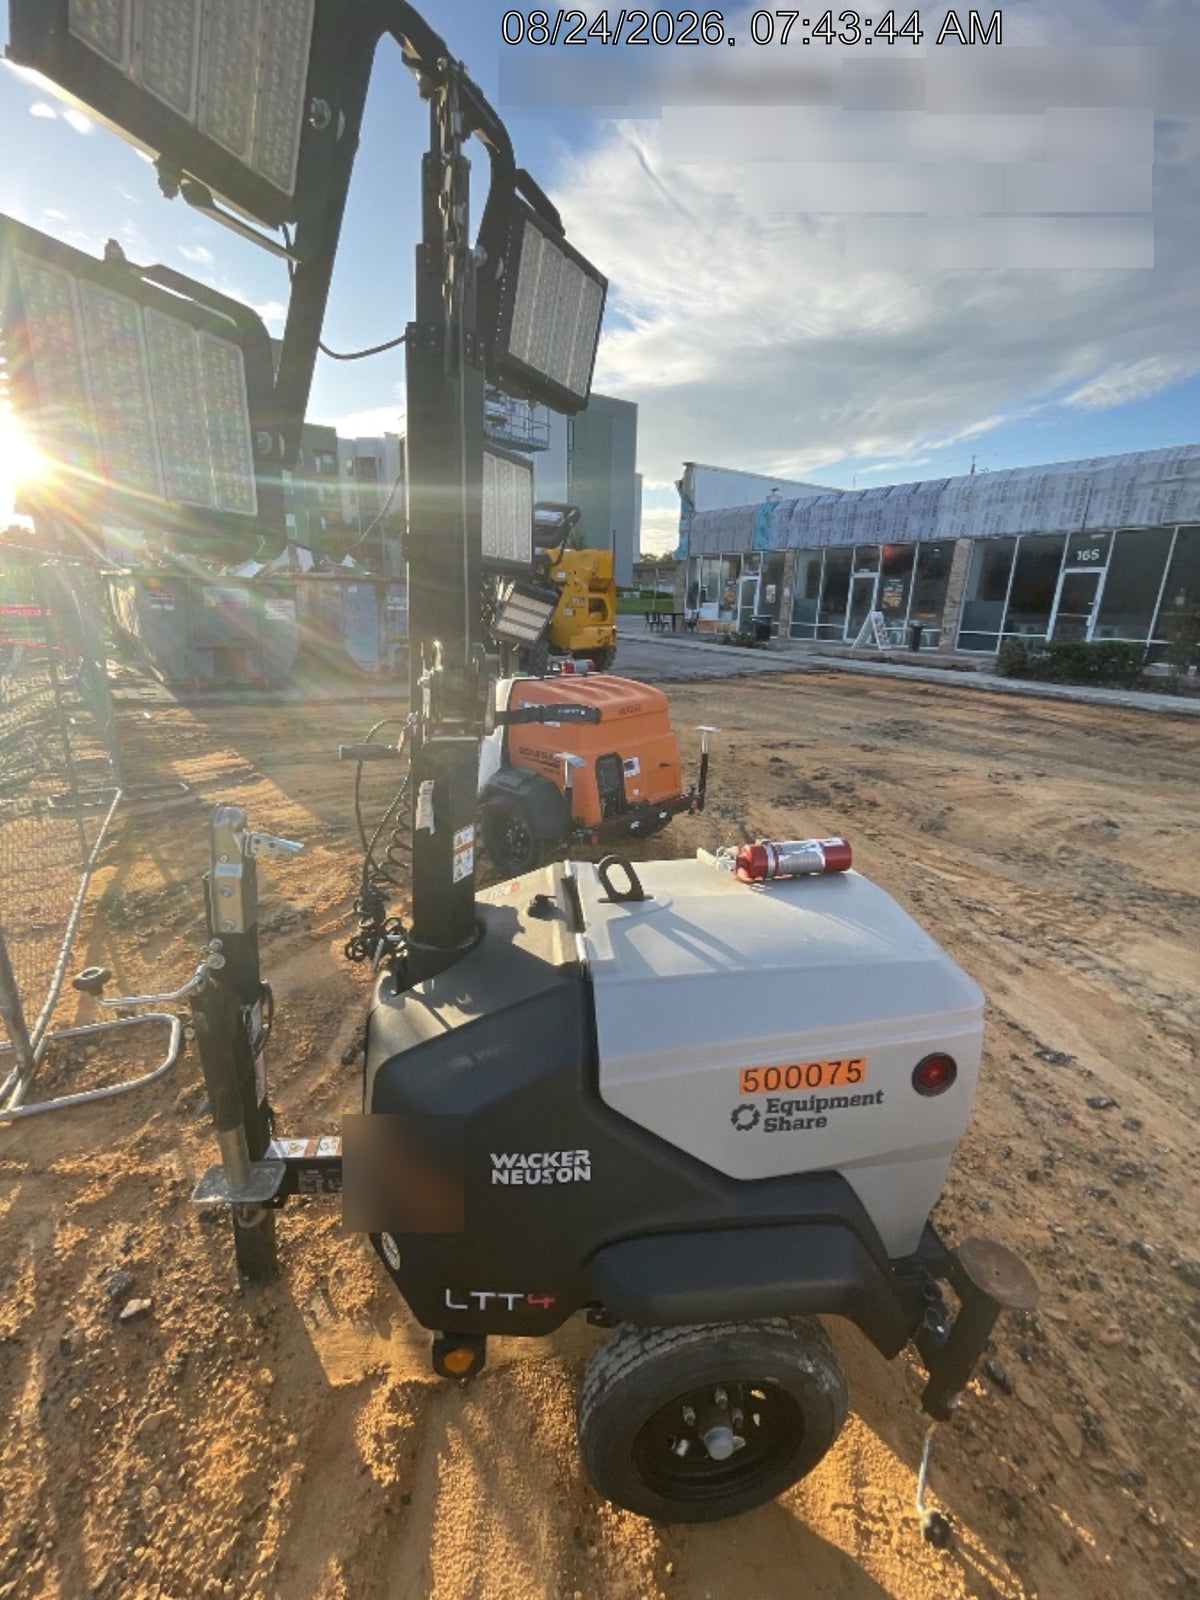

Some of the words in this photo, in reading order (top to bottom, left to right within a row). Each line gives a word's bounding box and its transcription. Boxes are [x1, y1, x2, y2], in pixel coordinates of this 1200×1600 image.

[742, 1059, 863, 1093] 500075
[765, 1089, 884, 1117] Equipment
[763, 1115, 828, 1133] Share
[490, 1150, 592, 1169] WACKER
[491, 1166, 592, 1185] NEUSON
[445, 1288, 556, 1311] LTT4
